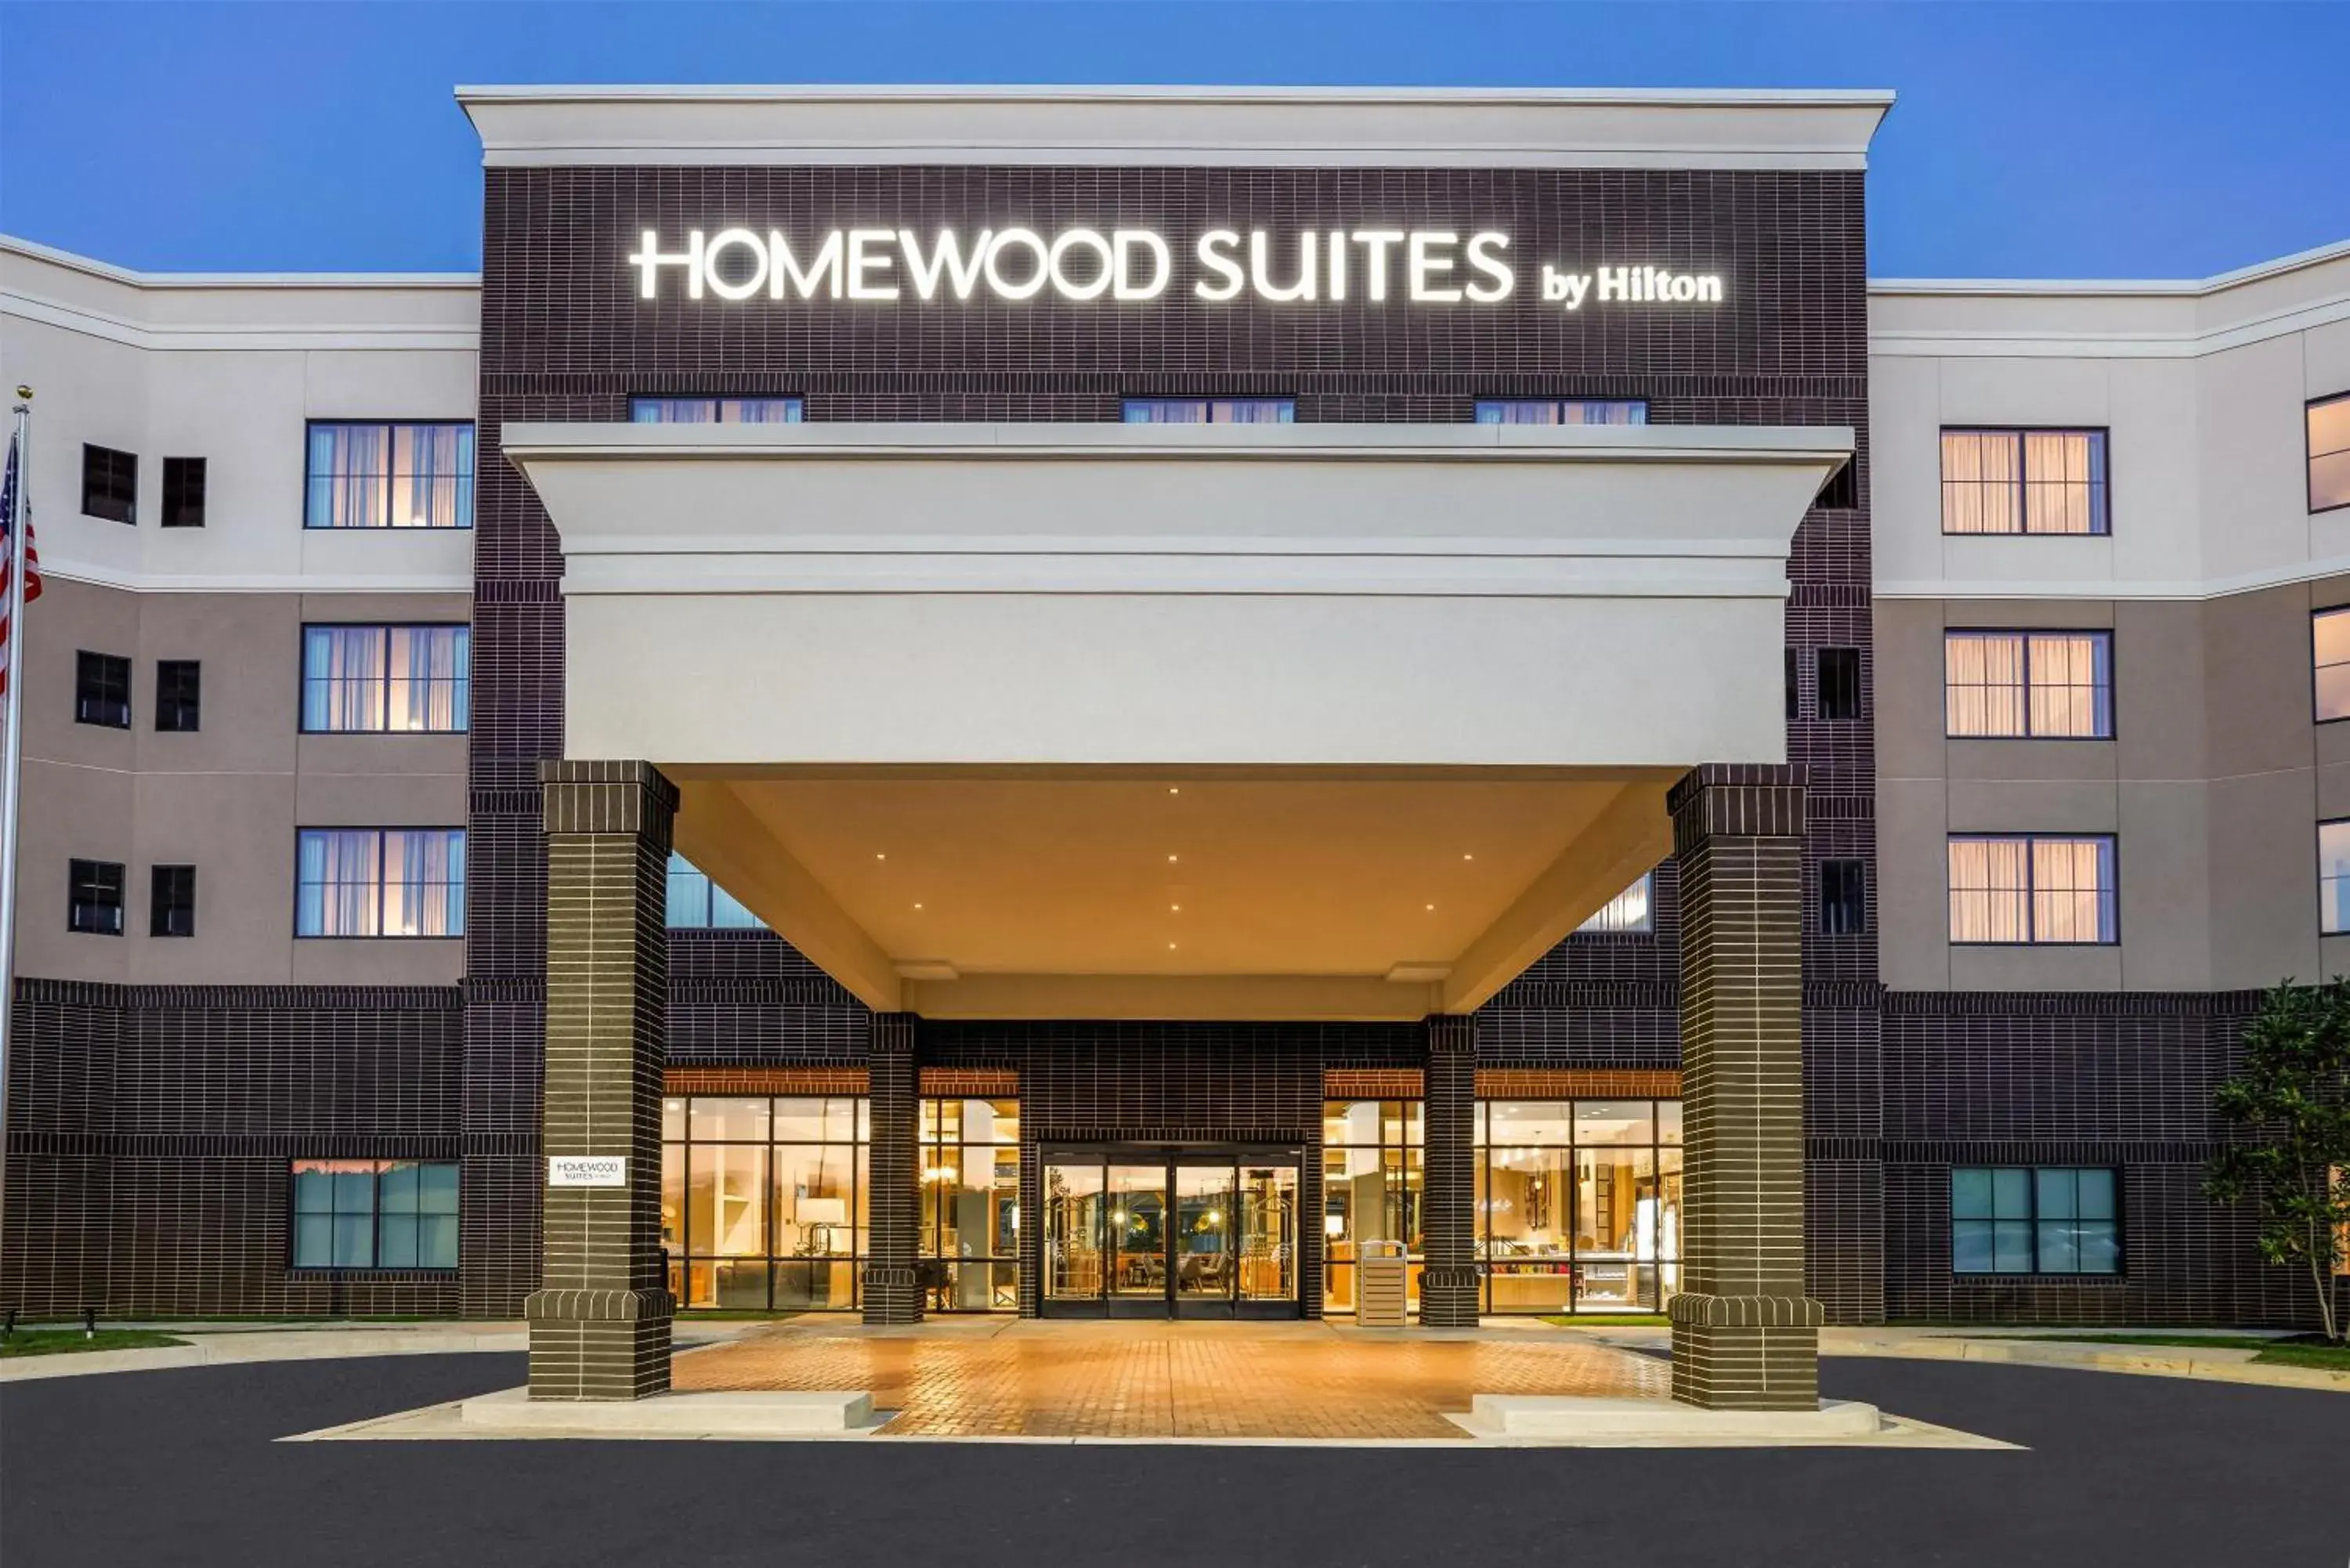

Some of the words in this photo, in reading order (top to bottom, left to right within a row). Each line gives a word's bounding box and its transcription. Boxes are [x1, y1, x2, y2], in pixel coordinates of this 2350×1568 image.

[629, 228, 1170, 300] HOMEWOOD
[1195, 229, 1513, 302] SUITES
[1542, 265, 1592, 309] by
[1597, 266, 1722, 301] Hilton
[557, 1162, 618, 1172] HOMEWOOD
